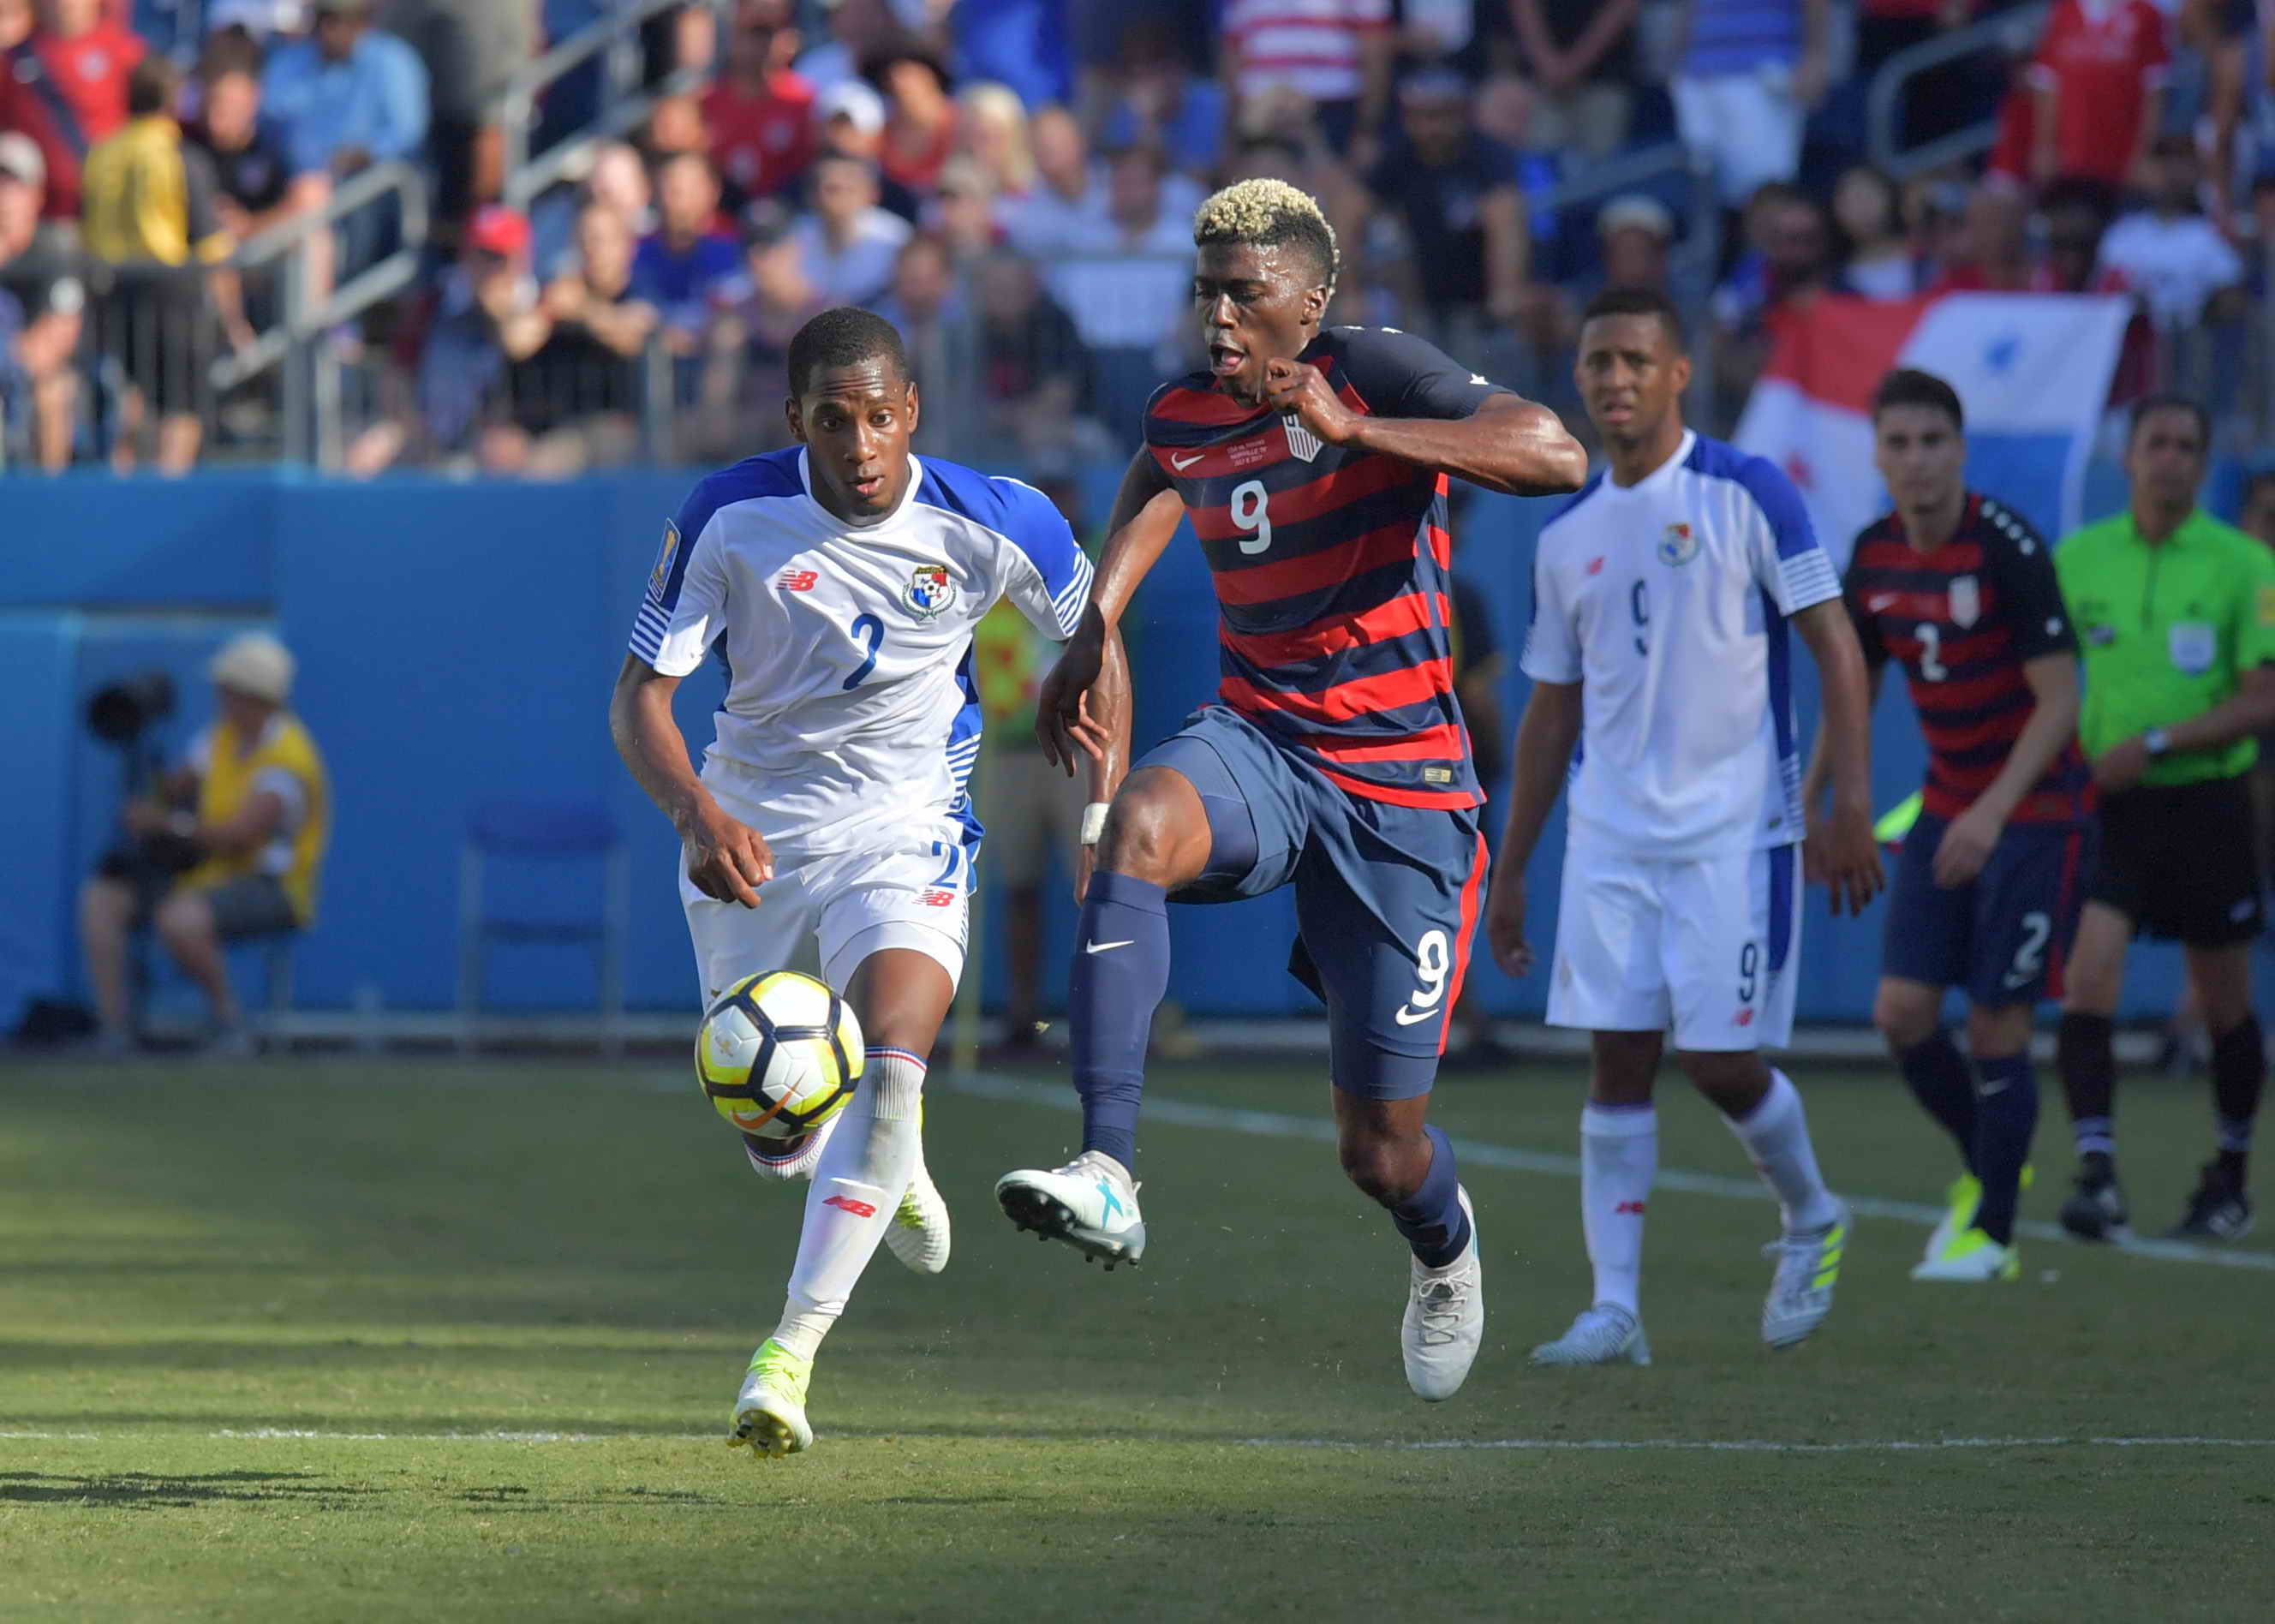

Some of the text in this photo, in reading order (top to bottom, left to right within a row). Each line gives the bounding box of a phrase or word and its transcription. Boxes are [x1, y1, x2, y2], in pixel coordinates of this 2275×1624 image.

[1231, 480, 1271, 555] 9
[842, 612, 884, 690] 2
[1914, 623, 1948, 683] 2
[929, 840, 959, 889] 2
[1412, 929, 1449, 1008] 9
[1739, 942, 1758, 1002] 9
[2014, 912, 2051, 974] 2
